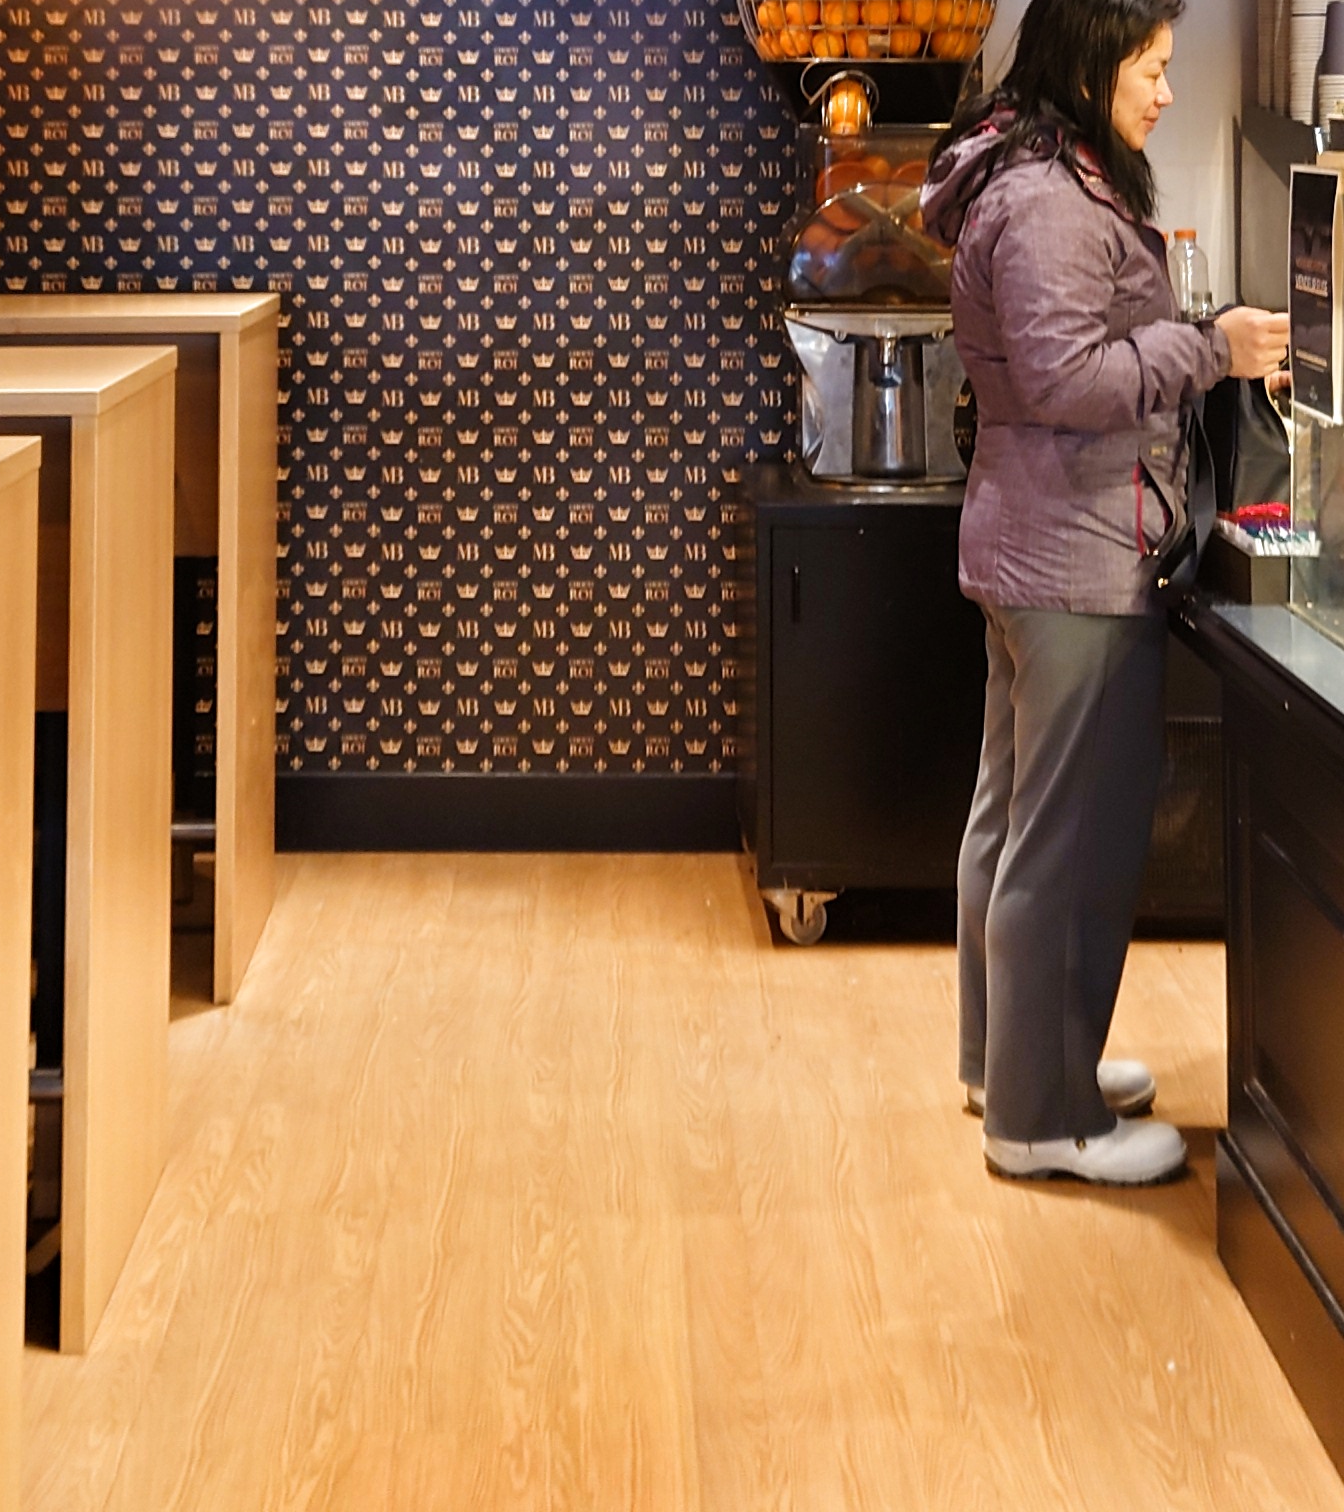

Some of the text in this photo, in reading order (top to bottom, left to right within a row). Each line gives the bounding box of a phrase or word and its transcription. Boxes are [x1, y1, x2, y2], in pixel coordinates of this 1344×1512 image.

[84, 9, 106, 26] MB
[234, 8, 256, 25] MB
[459, 11, 481, 28] MB
[8, 84, 30, 101] MB
[309, 84, 331, 101] MB
[158, 159, 180, 176] MB
[383, 161, 405, 178] MB
[533, 161, 555, 178] MB
[6, 236, 28, 253] MB
[308, 235, 330, 252] MB
[458, 237, 480, 254] MB
[684, 237, 706, 254] MB
[458, 313, 480, 330] MB
[307, 388, 329, 405] MB
[609, 390, 631, 407] MB
[382, 467, 404, 484] MB
[533, 543, 555, 560] MB
[685, 544, 707, 561] MB
[306, 619, 328, 636] MB
[609, 621, 631, 638] MB
[457, 699, 479, 716] MB
